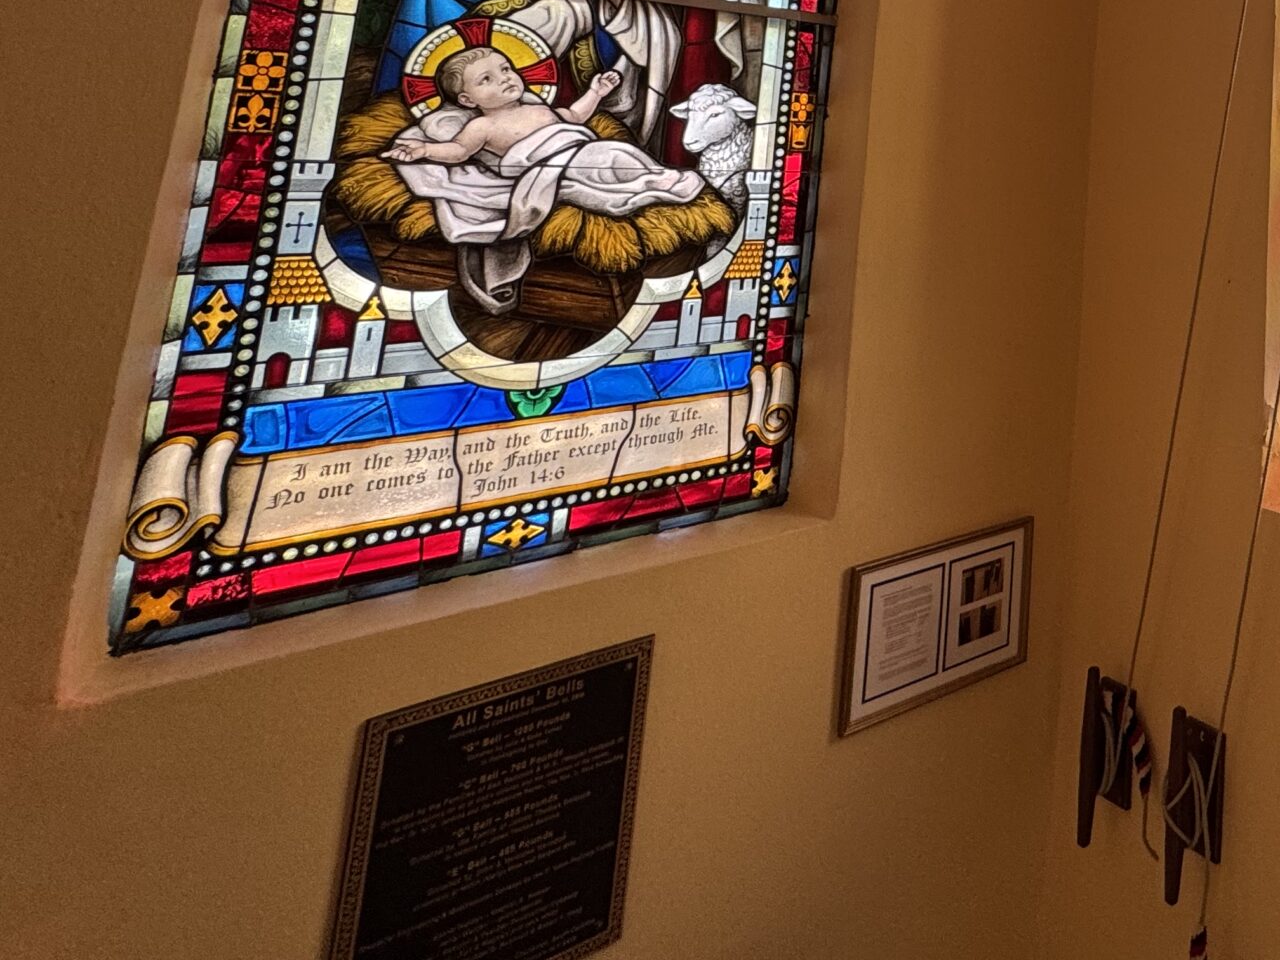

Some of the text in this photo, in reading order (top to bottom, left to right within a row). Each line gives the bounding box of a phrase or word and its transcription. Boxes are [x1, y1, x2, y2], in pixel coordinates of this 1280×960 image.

[263, 423, 718, 510] No one comes to the Father except through Me.
[290, 463, 309, 482] I
[319, 460, 351, 478] am
[363, 453, 394, 471] the
[463, 438, 496, 455] and
[505, 433, 531, 450] the
[601, 418, 628, 434] and
[639, 413, 661, 428] the
[669, 407, 701, 423] Life.
[470, 466, 566, 498] John 14:6
[451, 709, 477, 730] All
[483, 689, 540, 719] Saints'
[545, 679, 584, 700] Bells
